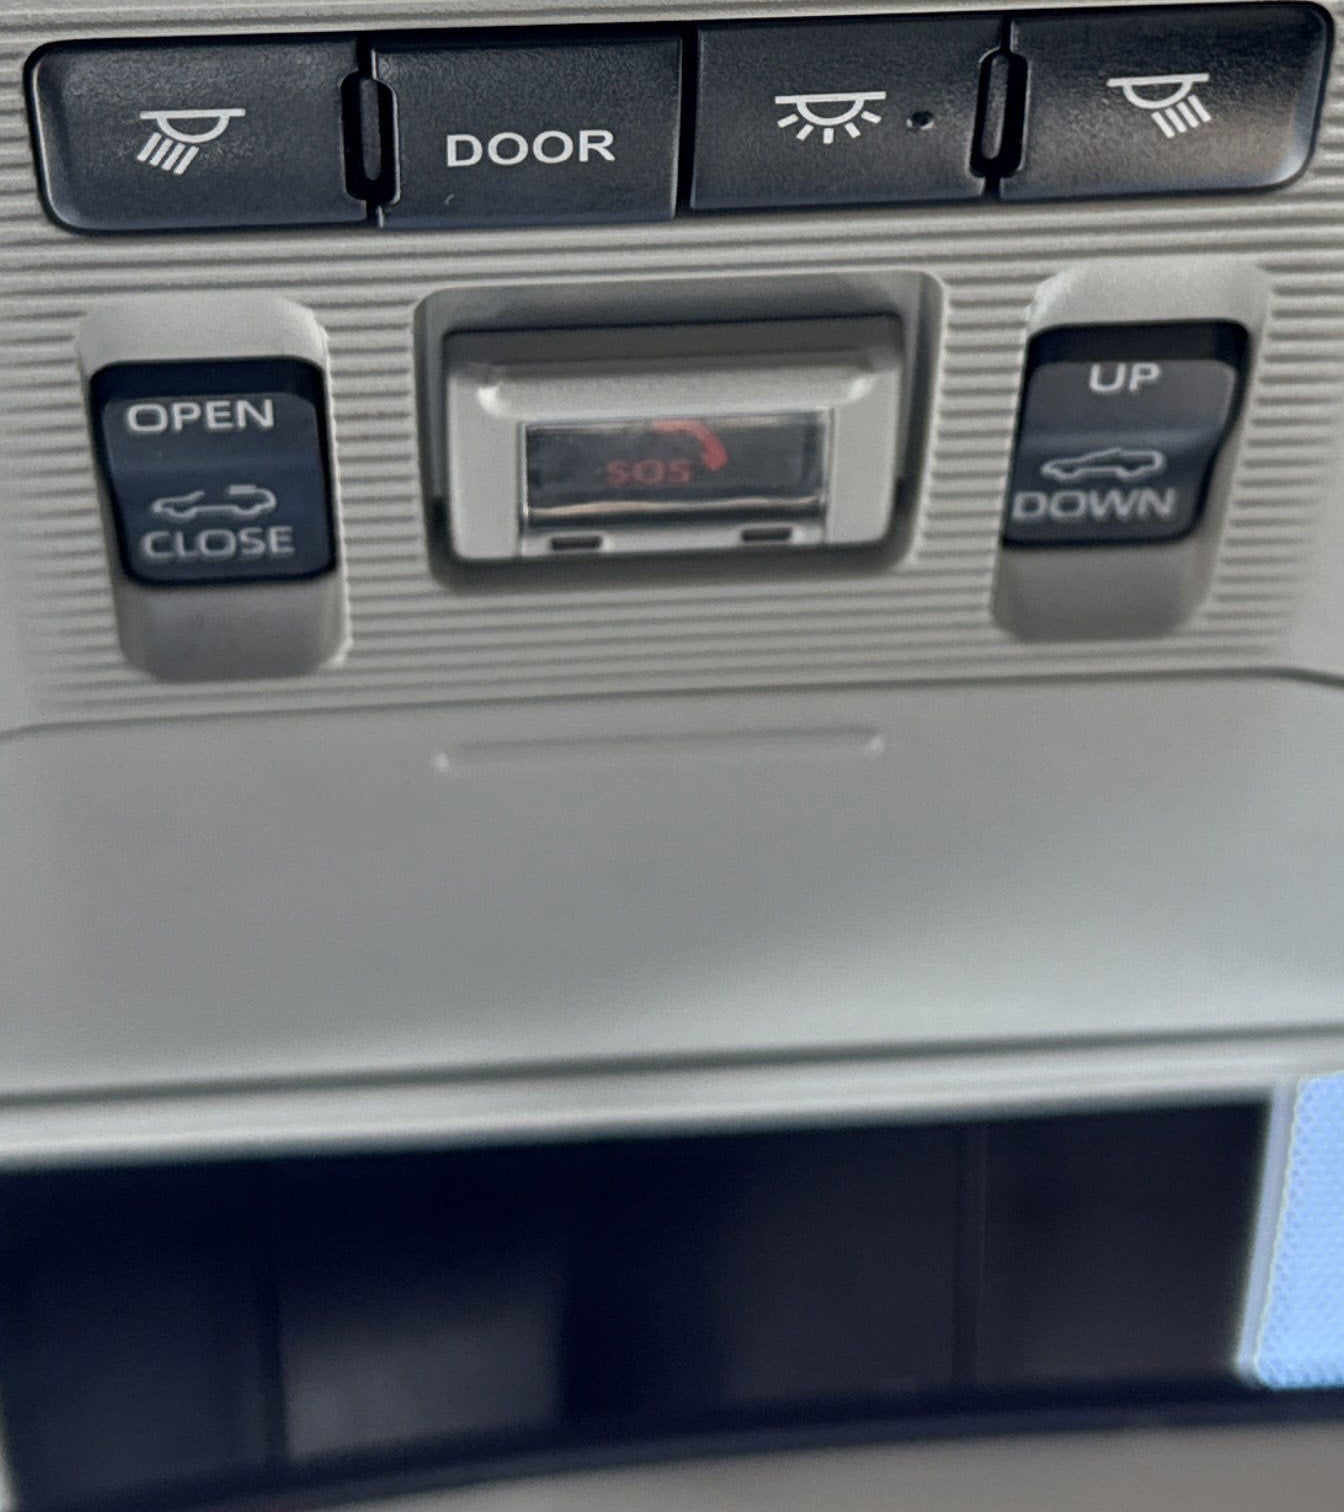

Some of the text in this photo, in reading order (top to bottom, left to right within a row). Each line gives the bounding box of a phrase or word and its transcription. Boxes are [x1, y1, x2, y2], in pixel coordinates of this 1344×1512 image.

[446, 128, 615, 169] DOOR
[1088, 362, 1162, 395] UP
[126, 398, 276, 434] OPEN
[606, 459, 693, 486] SOS
[1010, 487, 1179, 522] DOWN
[140, 524, 295, 562] CLOSE
